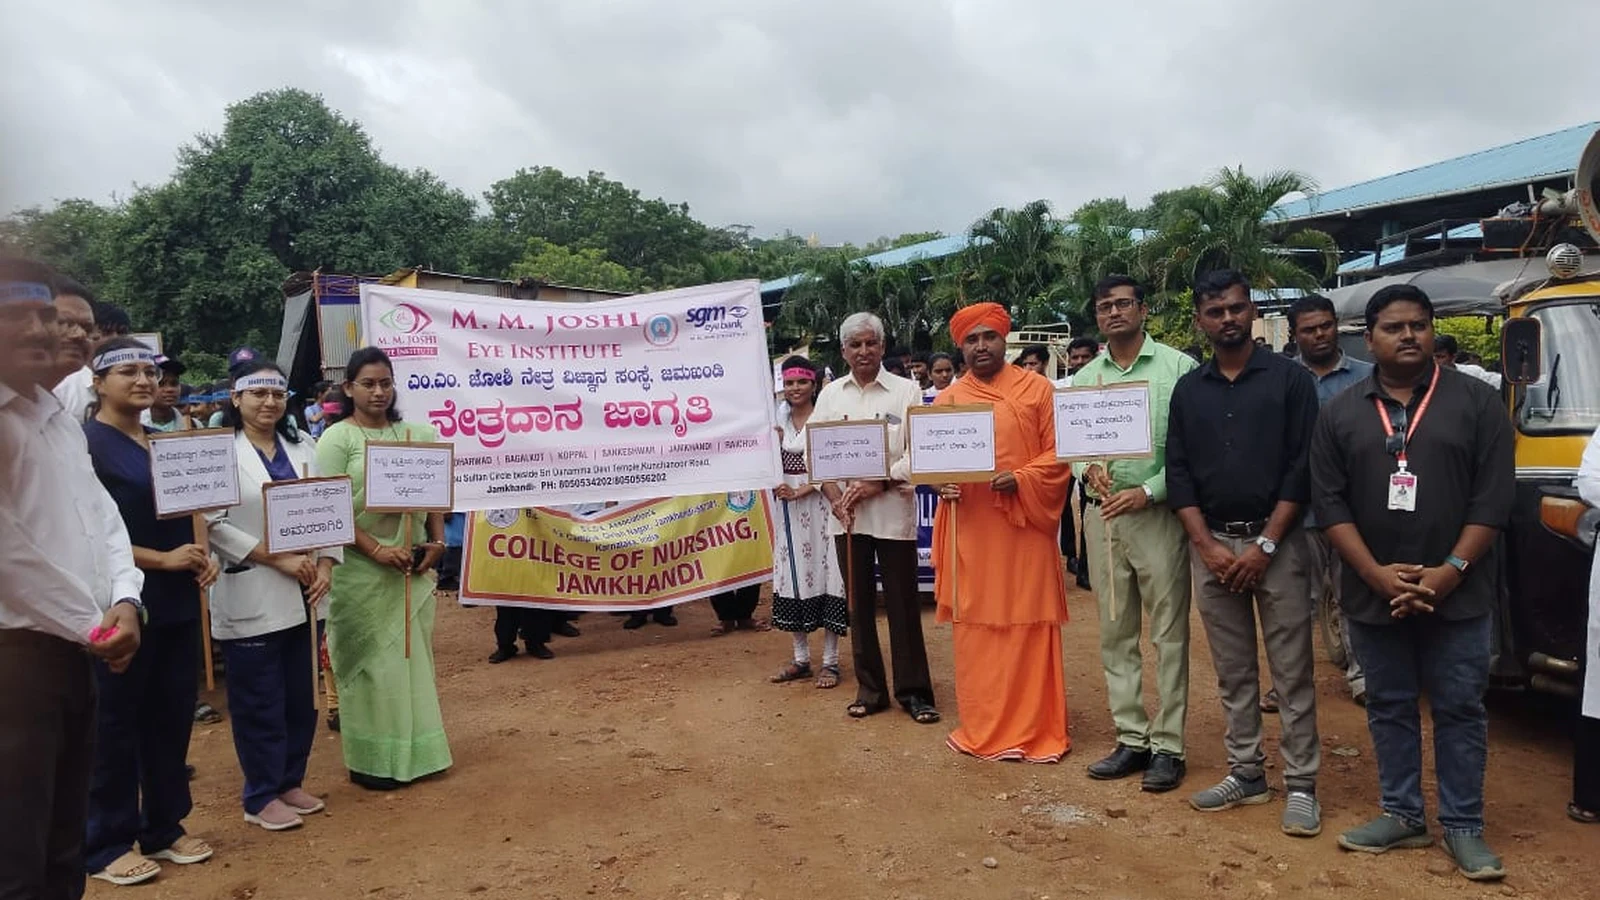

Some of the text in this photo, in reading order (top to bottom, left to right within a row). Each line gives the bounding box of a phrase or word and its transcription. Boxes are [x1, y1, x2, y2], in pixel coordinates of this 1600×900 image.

[452, 308, 641, 337] M. M. JOSHI
[686, 306, 726, 328] sgm
[408, 335, 437, 345] JOSHI
[468, 342, 623, 360] EYE INSTITUTE
[521, 367, 555, 390] ನೇತ್ರ
[660, 363, 725, 382] ಜಮಖಂಡಿ
[428, 391, 713, 448] ನೇತ್ರದಾನ ಜಾಗೃತಿ
[505, 453, 545, 464] BAGALKOT
[557, 451, 588, 462] KOPPAL
[541, 480, 557, 490] PH:
[488, 517, 758, 571] COLLEGE OF NURSING,
[556, 559, 705, 596] JAMKHANDI
